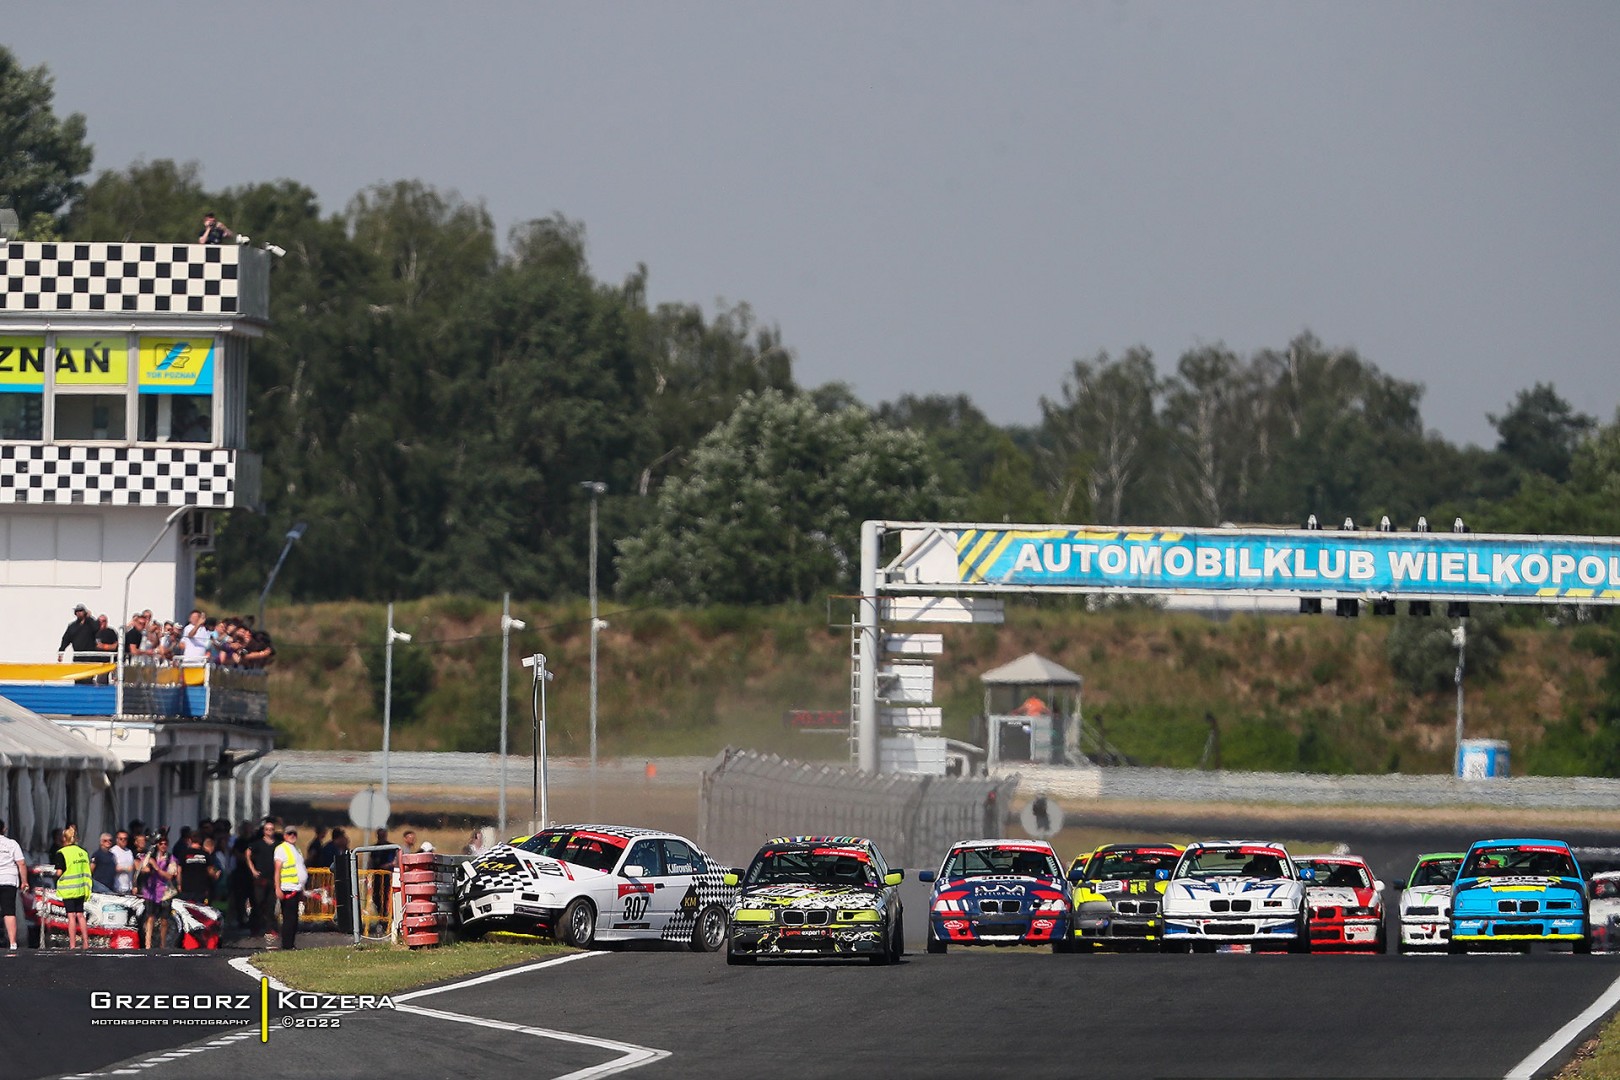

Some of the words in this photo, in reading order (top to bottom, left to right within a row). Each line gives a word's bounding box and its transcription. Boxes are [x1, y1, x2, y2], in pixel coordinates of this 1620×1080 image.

[1013, 543, 1375, 579] AUTOMOBILKLUB
[622, 896, 649, 921] 307
[684, 896, 697, 907] KM
[801, 929, 821, 937] expert
